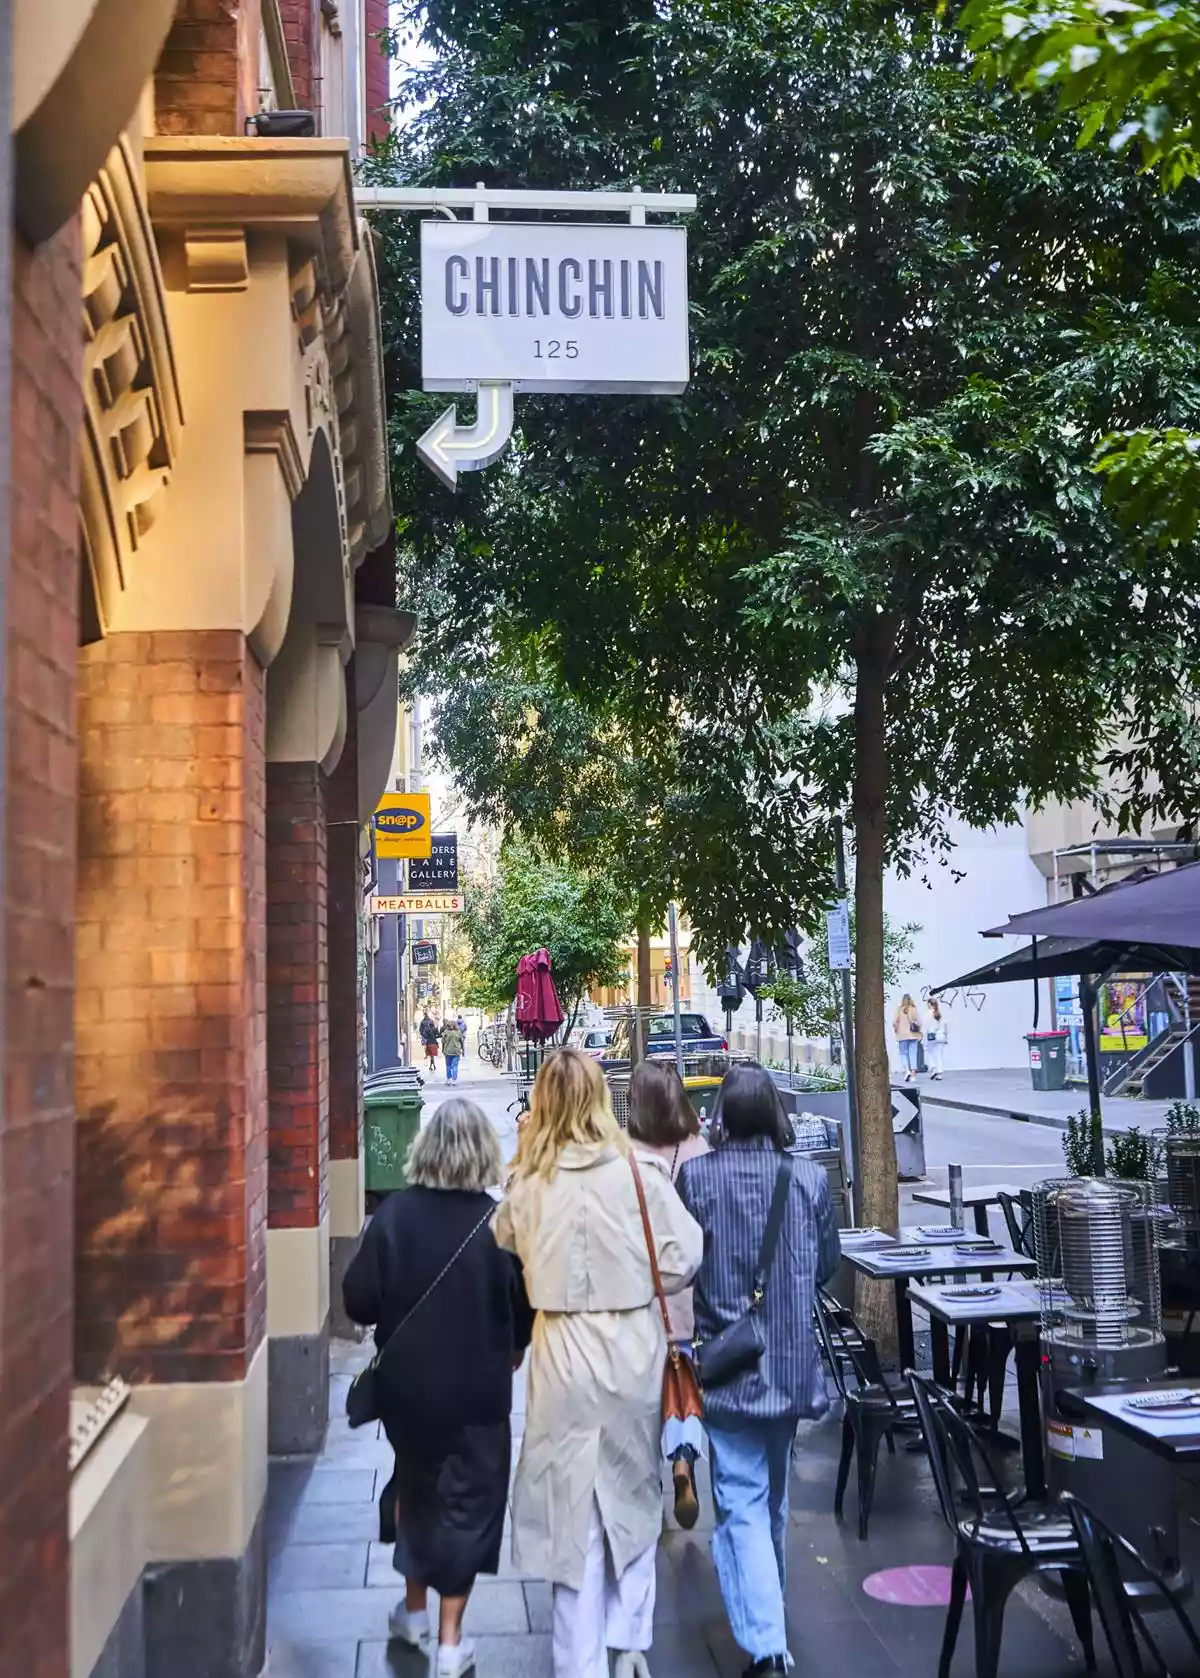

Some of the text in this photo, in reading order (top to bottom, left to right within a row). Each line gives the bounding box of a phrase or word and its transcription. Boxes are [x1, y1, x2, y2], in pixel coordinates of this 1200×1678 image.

[534, 340, 579, 358] 125
[378, 815, 417, 828] sn@p
[432, 846, 455, 854] DERS
[410, 858, 456, 866] LANE
[410, 870, 456, 879] GALLERY
[377, 898, 459, 910] MEATBALLS
